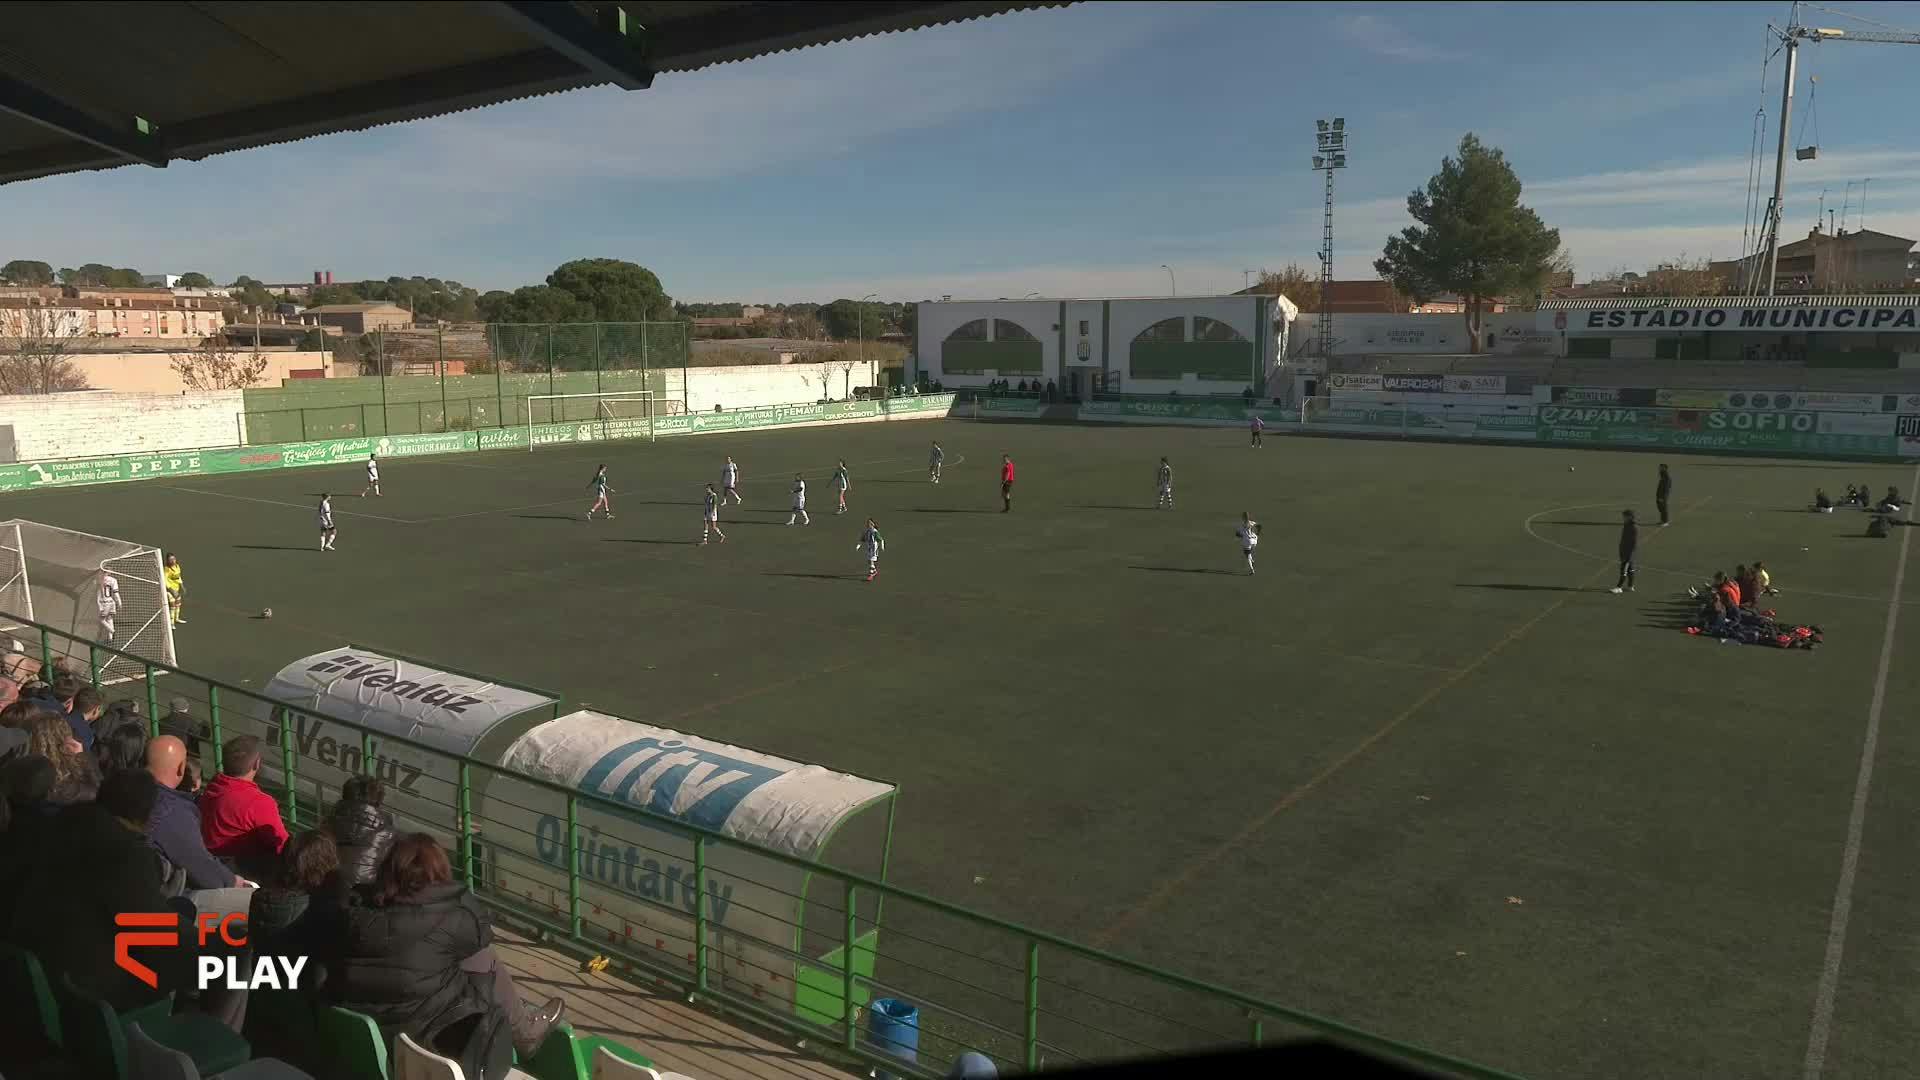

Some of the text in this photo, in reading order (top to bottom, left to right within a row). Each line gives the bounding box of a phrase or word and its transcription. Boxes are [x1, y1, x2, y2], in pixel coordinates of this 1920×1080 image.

[1587, 309, 1920, 328] ESTADIO MUNICIPA
[1558, 408, 1636, 424] ZAPATA
[1706, 411, 1813, 431] SOFIO
[130, 457, 201, 473] PEPE
[343, 662, 484, 714] Venluz
